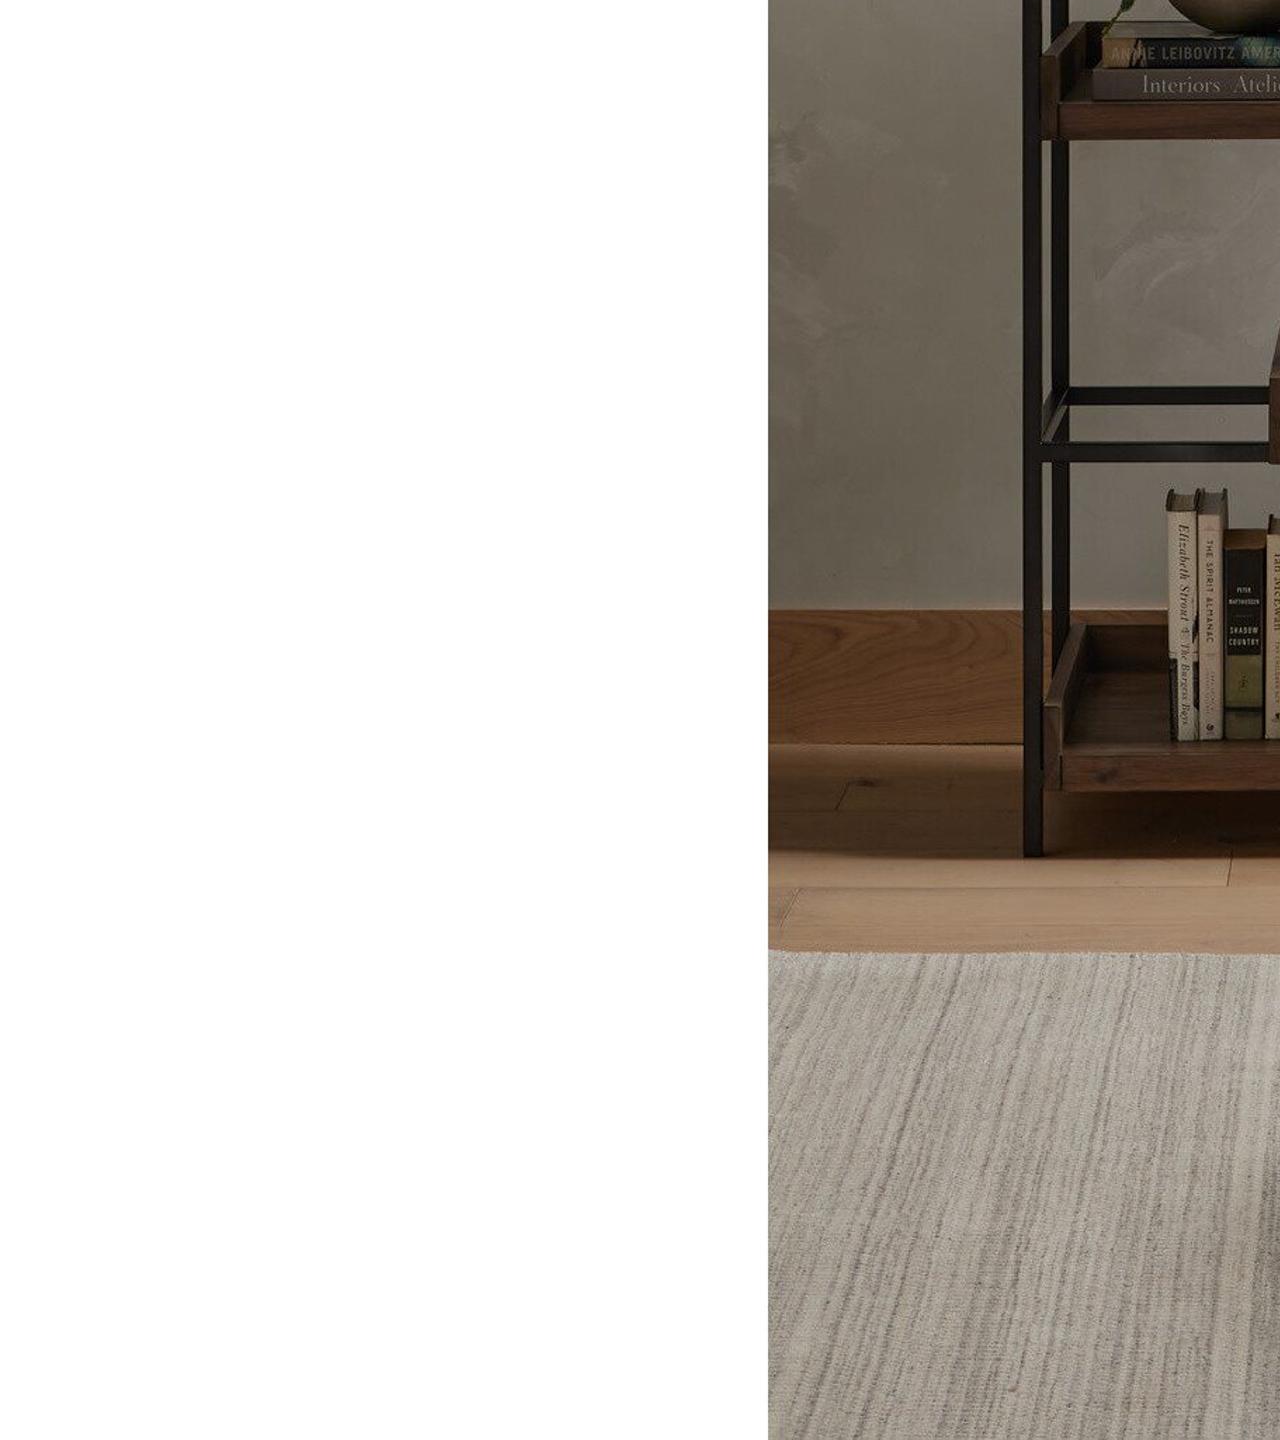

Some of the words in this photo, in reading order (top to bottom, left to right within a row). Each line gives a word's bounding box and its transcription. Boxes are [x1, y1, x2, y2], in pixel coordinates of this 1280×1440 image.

[1162, 46, 1236, 60] LEIBOVITZ
[1142, 74, 1221, 94] Interiors
[1178, 524, 1190, 580] Elizabeth
[1206, 540, 1214, 558] THE
[1206, 562, 1214, 592] SPIRIT
[1180, 584, 1190, 622] Strout
[1205, 597, 1214, 644] ALMANAC
